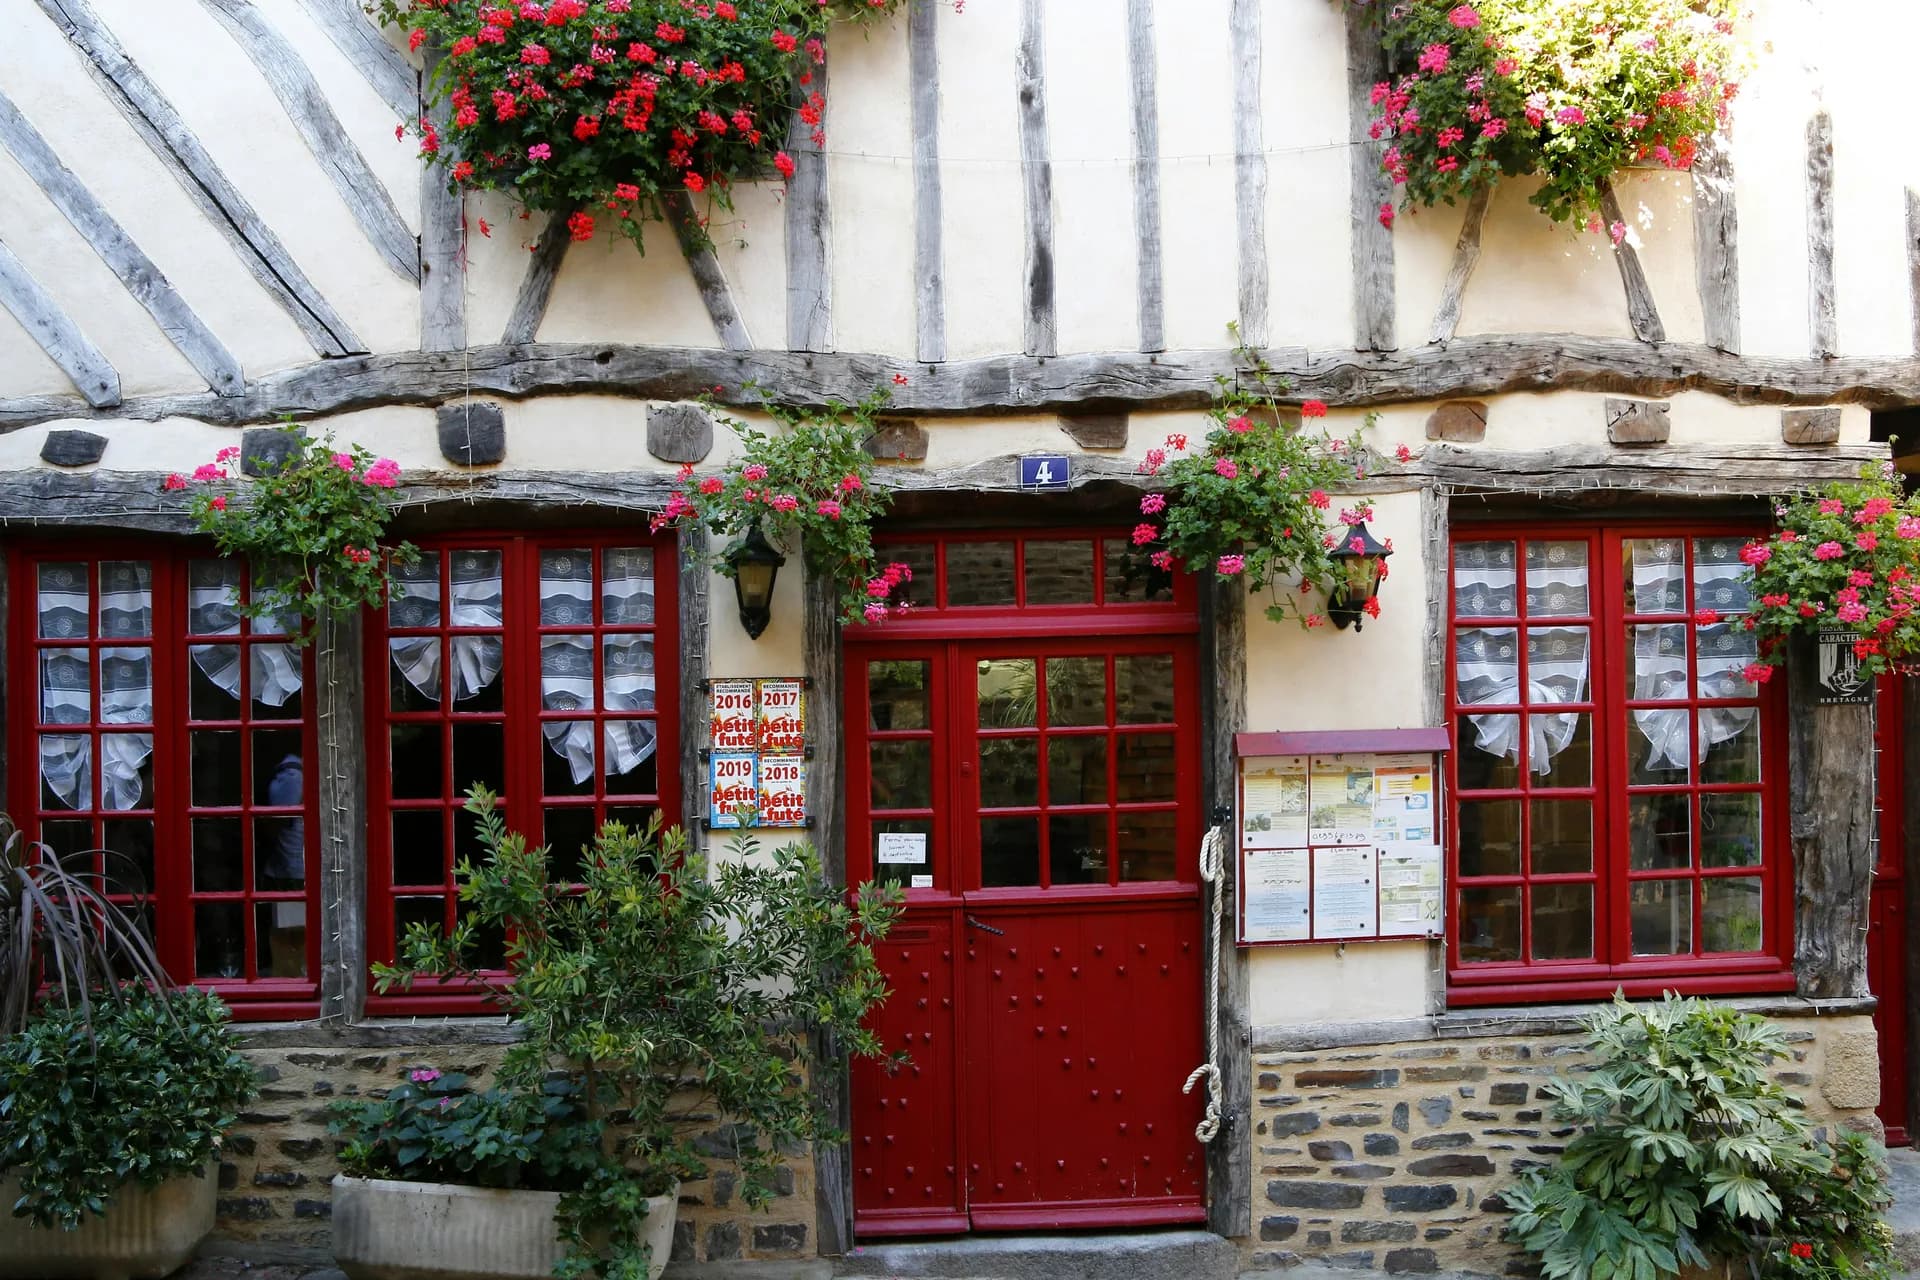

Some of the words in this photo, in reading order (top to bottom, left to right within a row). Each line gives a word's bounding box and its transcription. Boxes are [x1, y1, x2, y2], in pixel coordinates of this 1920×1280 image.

[1035, 461, 1053, 484] 4
[1819, 634, 1864, 643] CARACTER
[715, 694, 752, 709] 2016
[763, 693, 798, 706] 2017
[1820, 696, 1868, 704] BRETAGNE
[711, 718, 756, 737] petit
[759, 718, 804, 737] petit
[719, 732, 756, 747] futé
[765, 733, 804, 747] futé
[716, 761, 752, 777] 2019
[764, 767, 799, 781] 2018
[712, 787, 756, 805] petit
[759, 793, 804, 811] petit
[766, 808, 804, 821] futé
